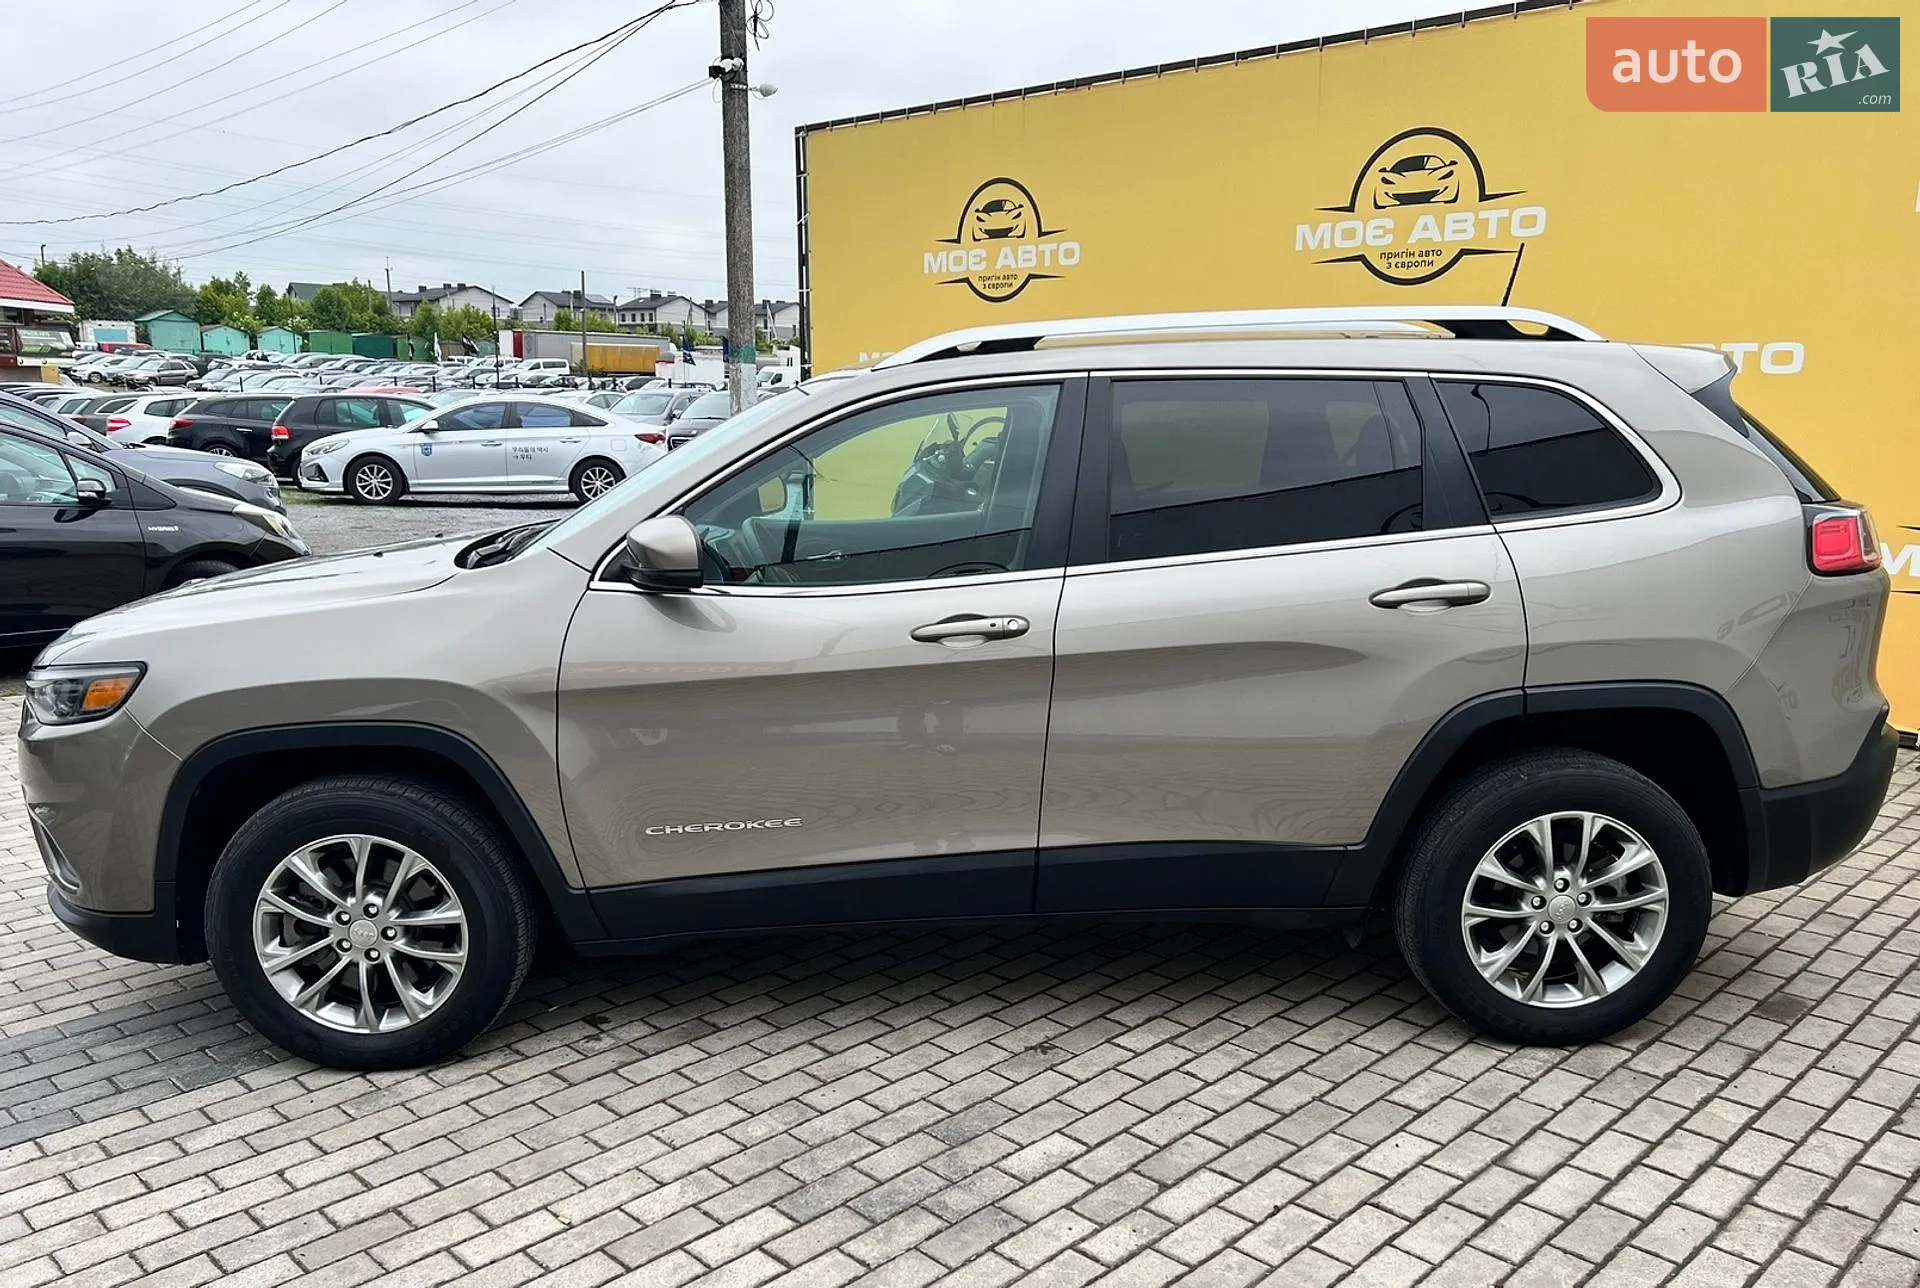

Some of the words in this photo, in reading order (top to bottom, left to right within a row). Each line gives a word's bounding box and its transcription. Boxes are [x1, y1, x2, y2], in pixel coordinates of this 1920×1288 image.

[1295, 219, 1395, 250] МОЄ
[1407, 206, 1546, 244] АВТО
[923, 249, 987, 273] МОЄ
[995, 242, 1081, 269] АВТО
[1380, 248, 1415, 261] пригін
[1418, 248, 1442, 258] авто
[1386, 261, 1392, 269] з
[1395, 260, 1434, 270] європи
[978, 273, 1001, 283] пригін
[1002, 273, 1018, 281] авто
[645, 817, 803, 835] CHEROKEE
